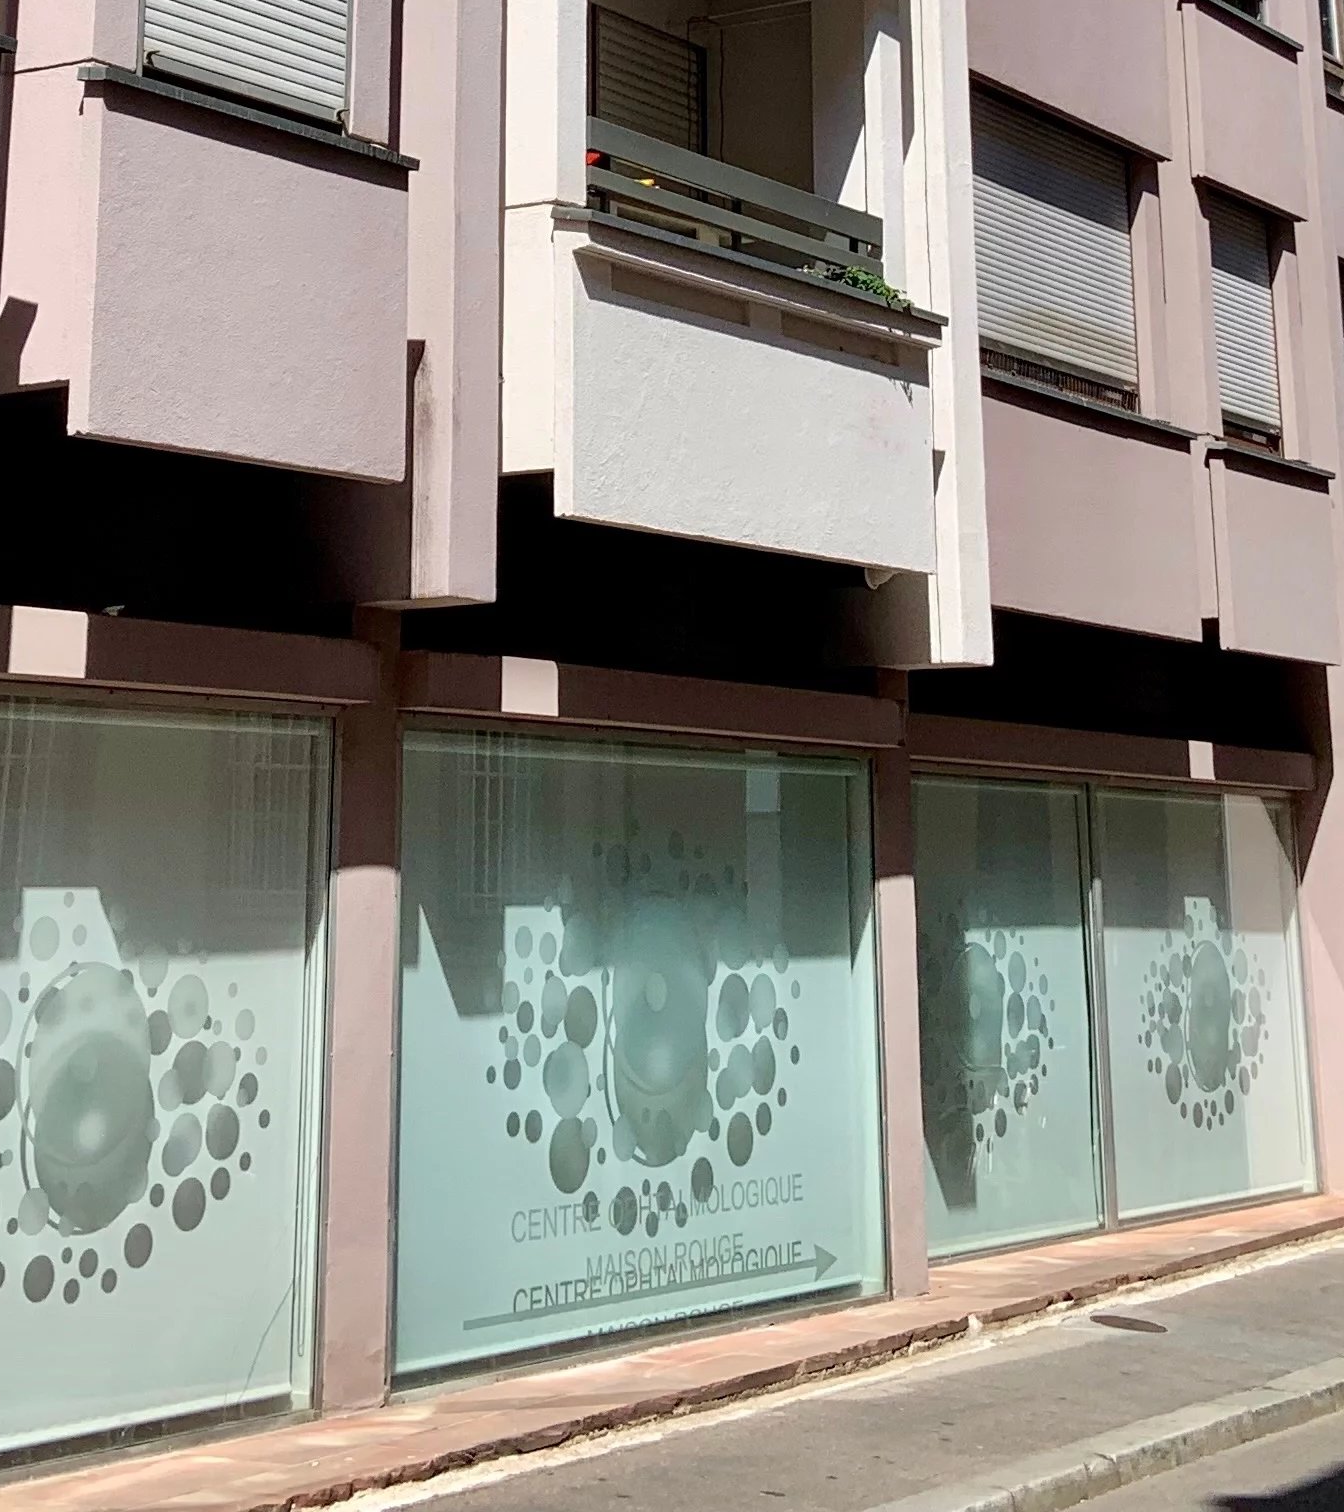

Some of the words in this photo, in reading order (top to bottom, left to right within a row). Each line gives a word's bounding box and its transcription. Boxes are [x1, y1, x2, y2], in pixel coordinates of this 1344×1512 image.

[512, 1201, 602, 1243] CENTRE
[587, 1246, 667, 1287] MAISON
[675, 1234, 744, 1271] ROUGE
